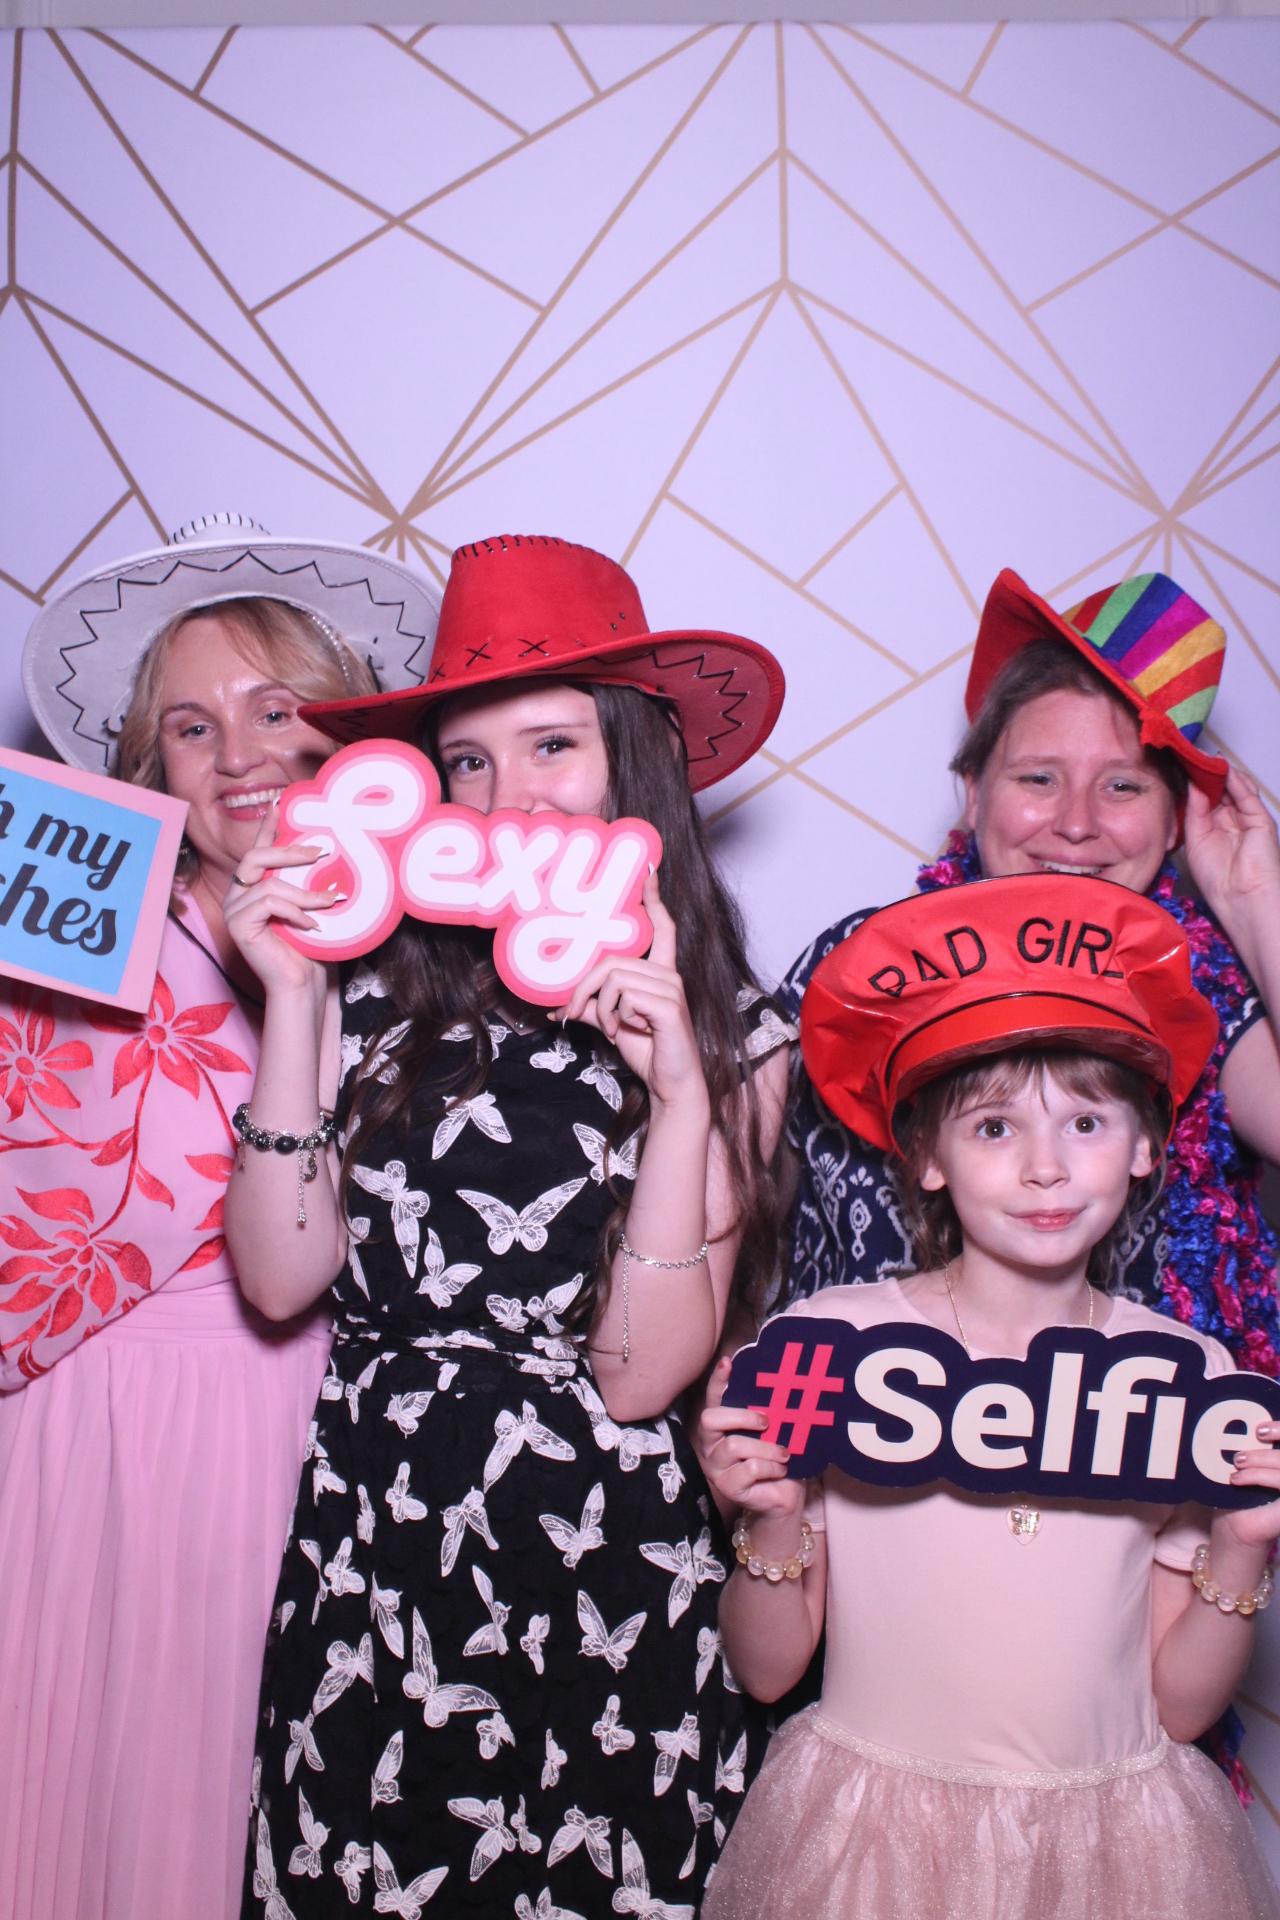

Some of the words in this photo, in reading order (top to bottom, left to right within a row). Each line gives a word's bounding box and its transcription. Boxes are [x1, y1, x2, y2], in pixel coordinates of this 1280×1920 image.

[0, 862, 118, 956] hes
[24, 812, 132, 892] my
[278, 760, 642, 985] Sexy
[747, 1341, 1276, 1486] #Selfie
